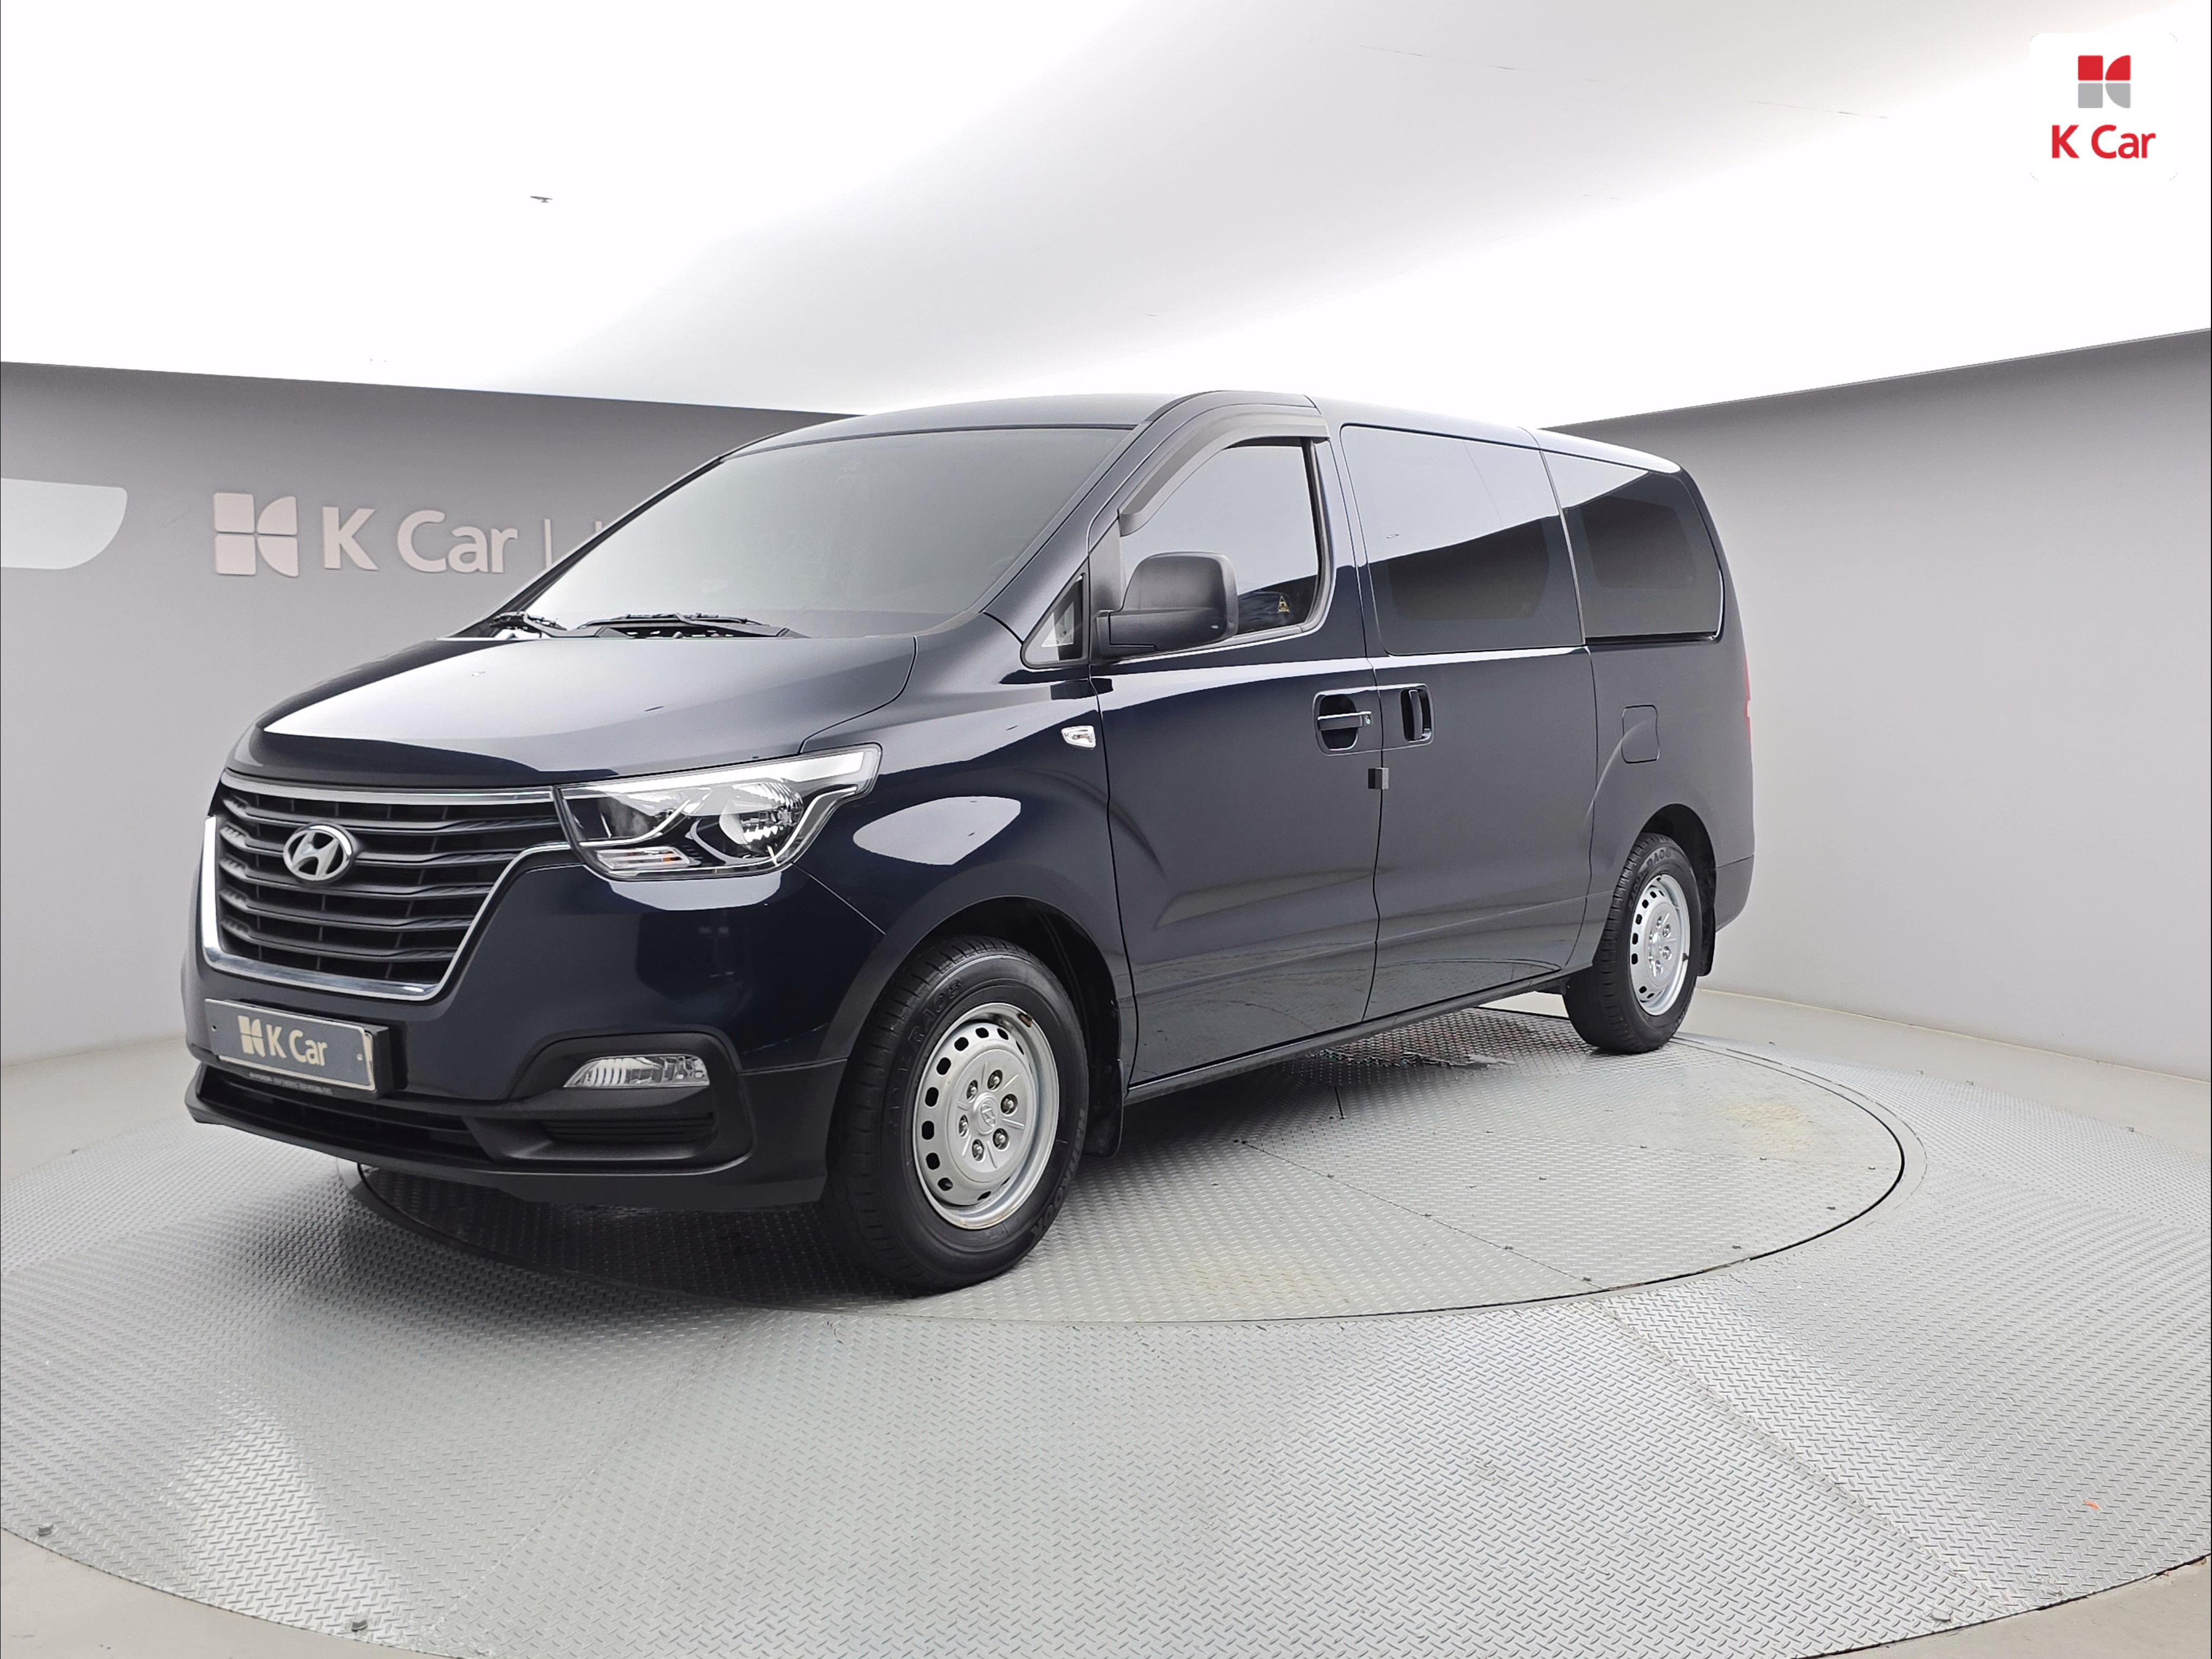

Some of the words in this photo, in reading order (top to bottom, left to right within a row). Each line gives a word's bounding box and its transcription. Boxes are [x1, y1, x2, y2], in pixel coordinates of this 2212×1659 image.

[322, 506, 378, 571] K
[396, 509, 518, 573] Car
[266, 1024, 287, 1058] K
[289, 1030, 327, 1066] Car
